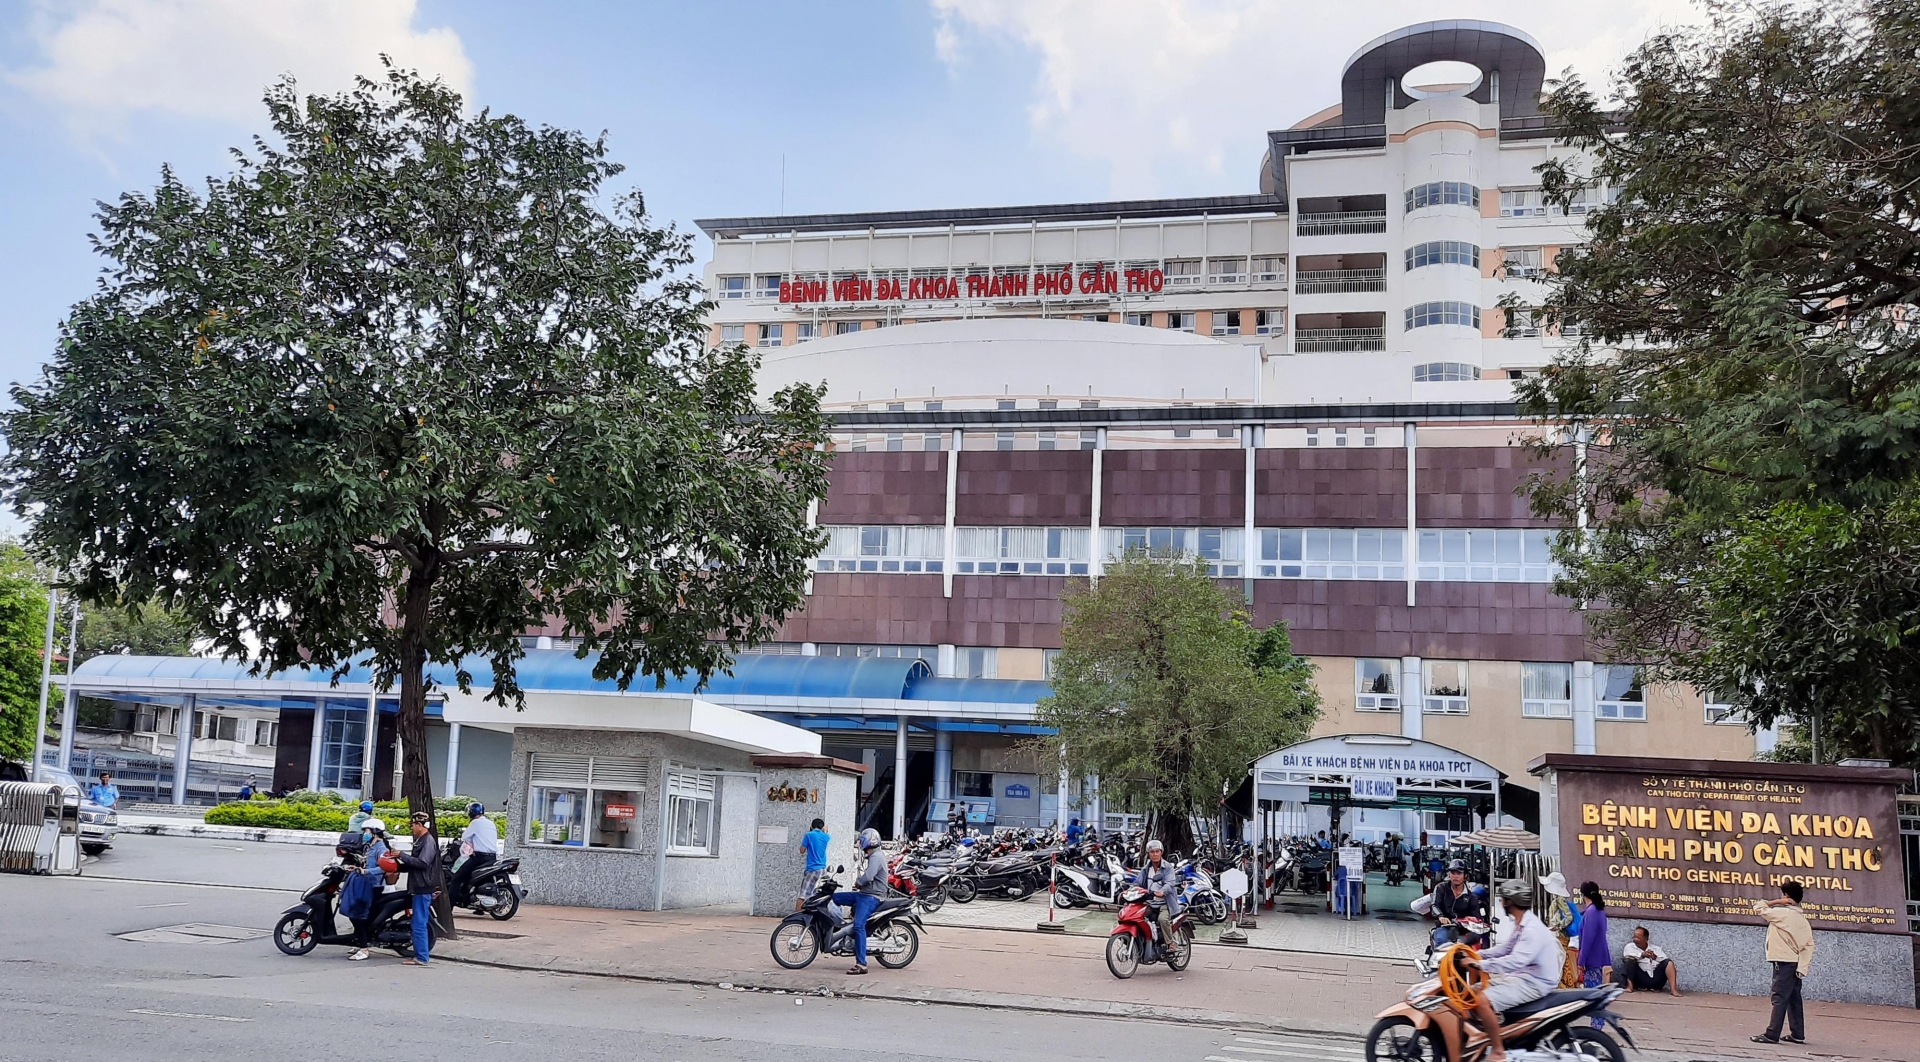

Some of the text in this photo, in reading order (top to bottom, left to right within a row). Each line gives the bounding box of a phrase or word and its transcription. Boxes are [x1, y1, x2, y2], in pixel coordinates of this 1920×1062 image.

[877, 278, 903, 301] ĐA
[908, 276, 960, 300] KHOA
[965, 268, 1028, 298] THÀNH
[1033, 262, 1074, 296] PHỐ
[1283, 753, 1472, 773] BÃI XE KHÁCH BỆNH VIỆN ĐA KHOA TPCT
[1365, 780, 1373, 796] XE
[1374, 777, 1394, 797] KHÁCH
[1660, 778, 1669, 787] Y
[1646, 789, 1802, 804] CAN THO CITY DEPARTMENT OF HEALTH
[1582, 800, 1874, 840] BỆNH VIỆN ĐA KHOA
[1578, 830, 1676, 861] THÀNH
[1608, 864, 1853, 891] CAN THO GENERAL HOSPITAL
[1646, 890, 1663, 900] LIÊM
[1678, 894, 1696, 902] NINH
